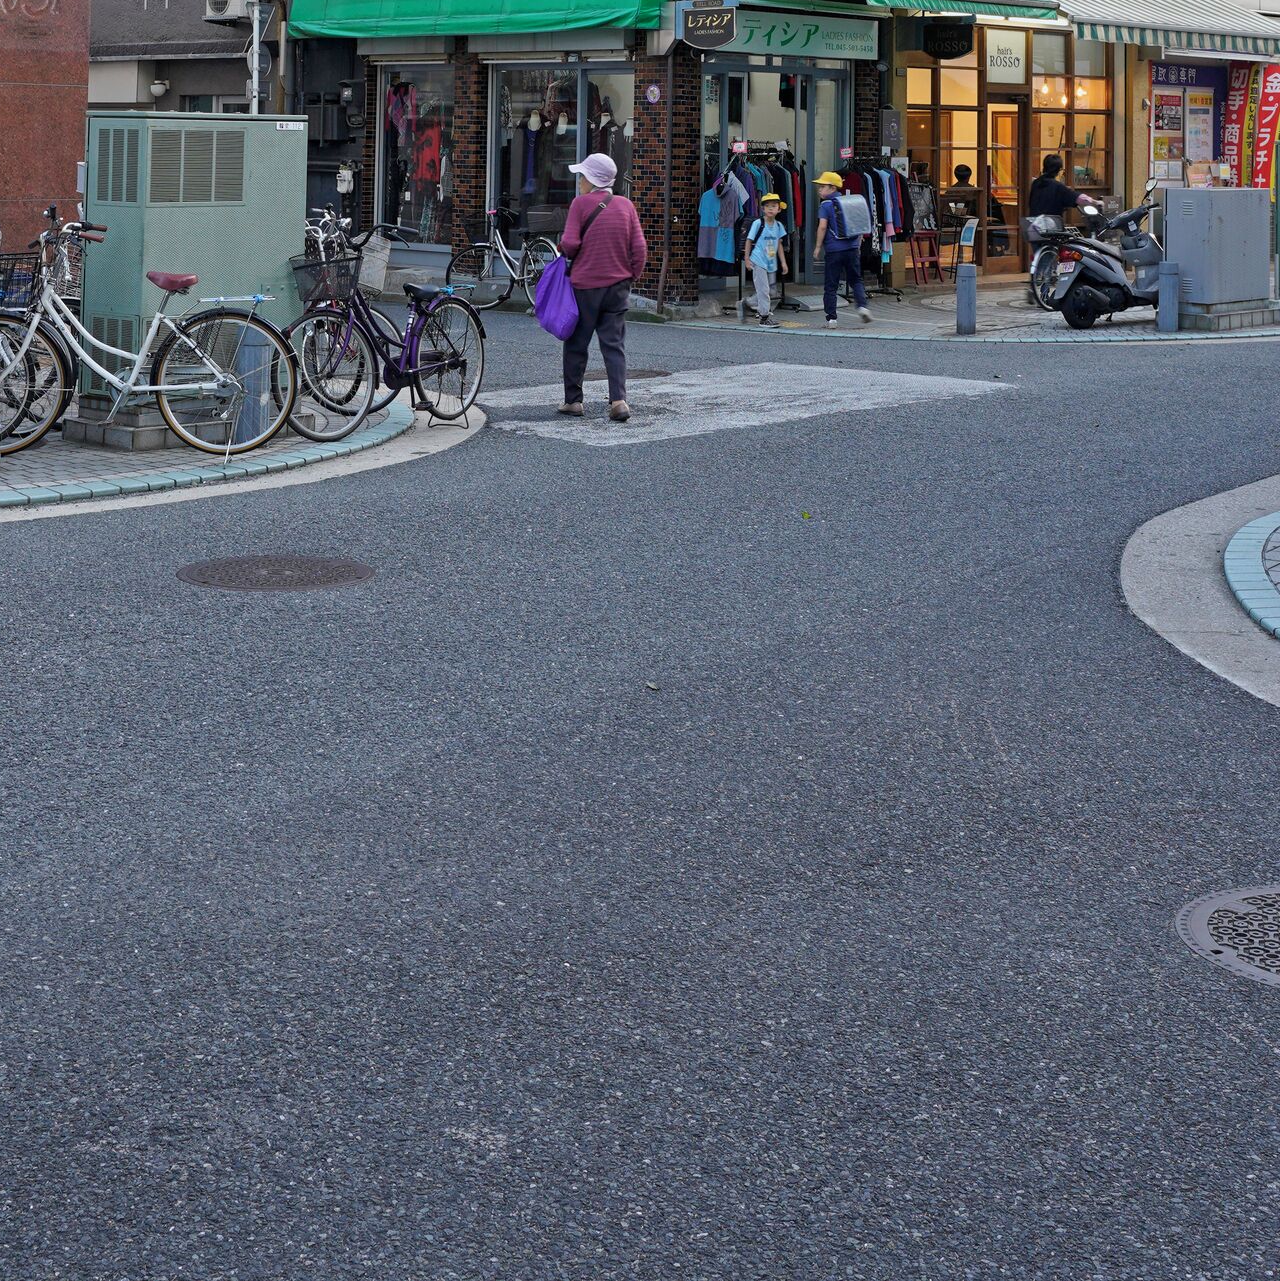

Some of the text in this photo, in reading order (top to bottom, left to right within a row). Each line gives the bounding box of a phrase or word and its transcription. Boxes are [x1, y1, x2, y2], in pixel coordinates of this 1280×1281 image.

[737, 19, 820, 49] ティシア
[821, 31, 874, 43] LADIES FASHION
[996, 44, 1013, 56] hair's
[989, 55, 1021, 68] ROSSO
